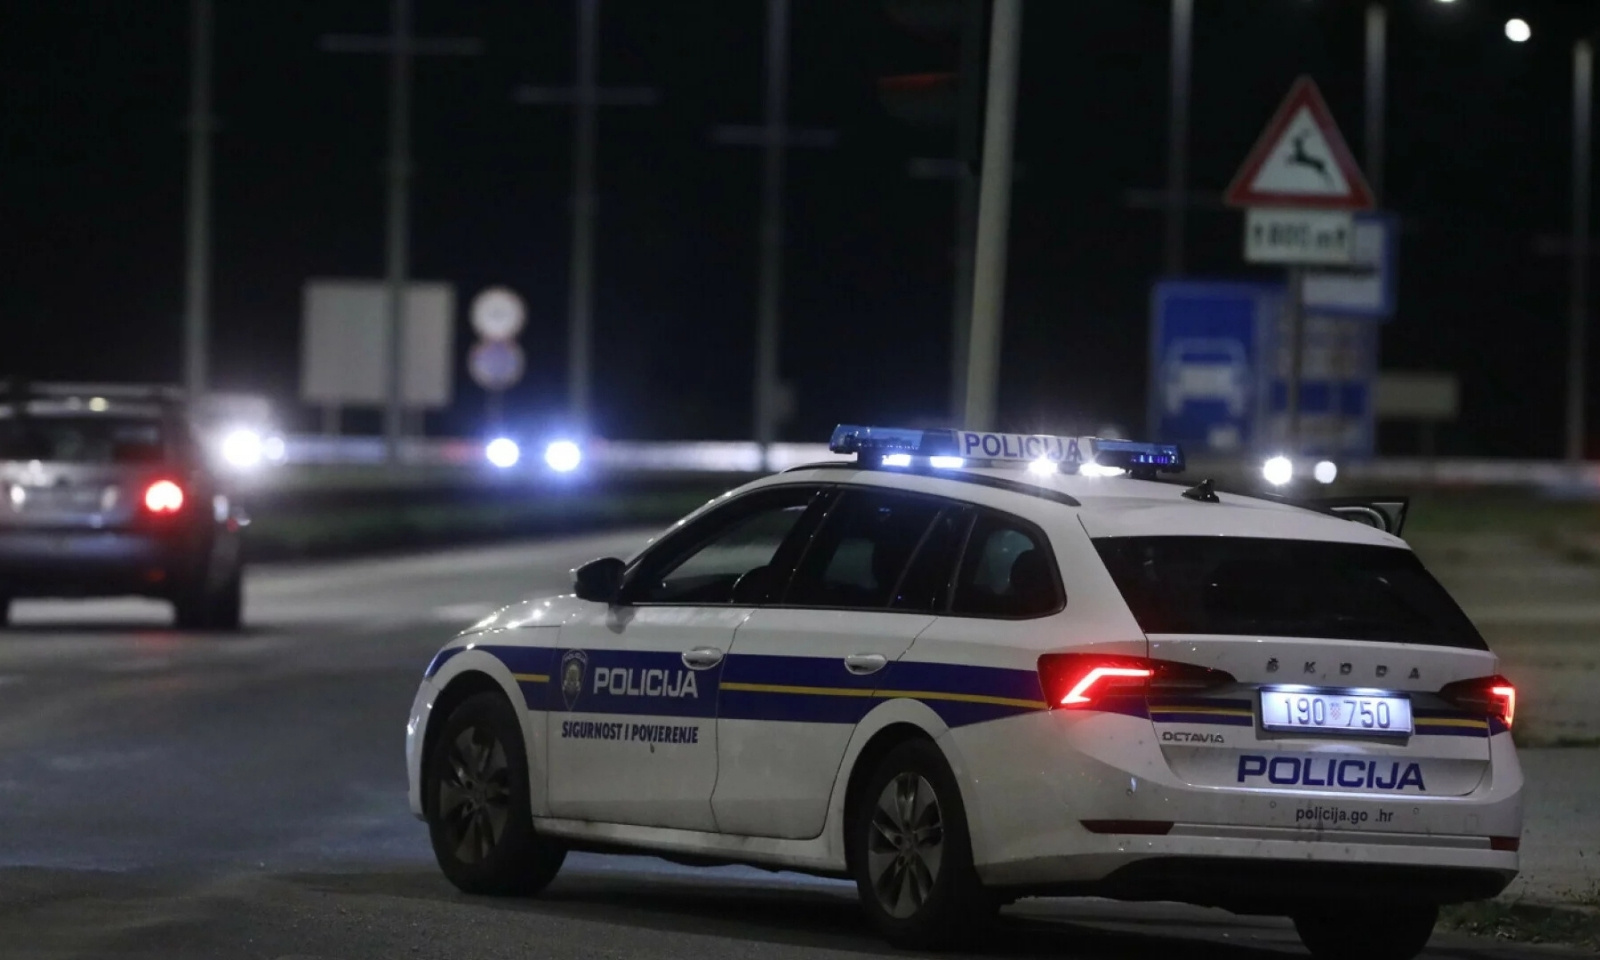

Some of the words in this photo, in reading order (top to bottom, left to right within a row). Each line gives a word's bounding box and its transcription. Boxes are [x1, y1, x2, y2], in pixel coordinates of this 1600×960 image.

[964, 433, 1083, 461] POLICIJA
[593, 667, 698, 698] POLICIJA
[1285, 698, 1326, 725] 190
[1344, 700, 1391, 729] 750
[562, 721, 623, 740] SIGURNOST
[624, 724, 630, 740] I
[632, 723, 699, 744] POVJERENJE
[1162, 731, 1225, 743] OCTAVIA
[1237, 755, 1426, 791] POLICIJA
